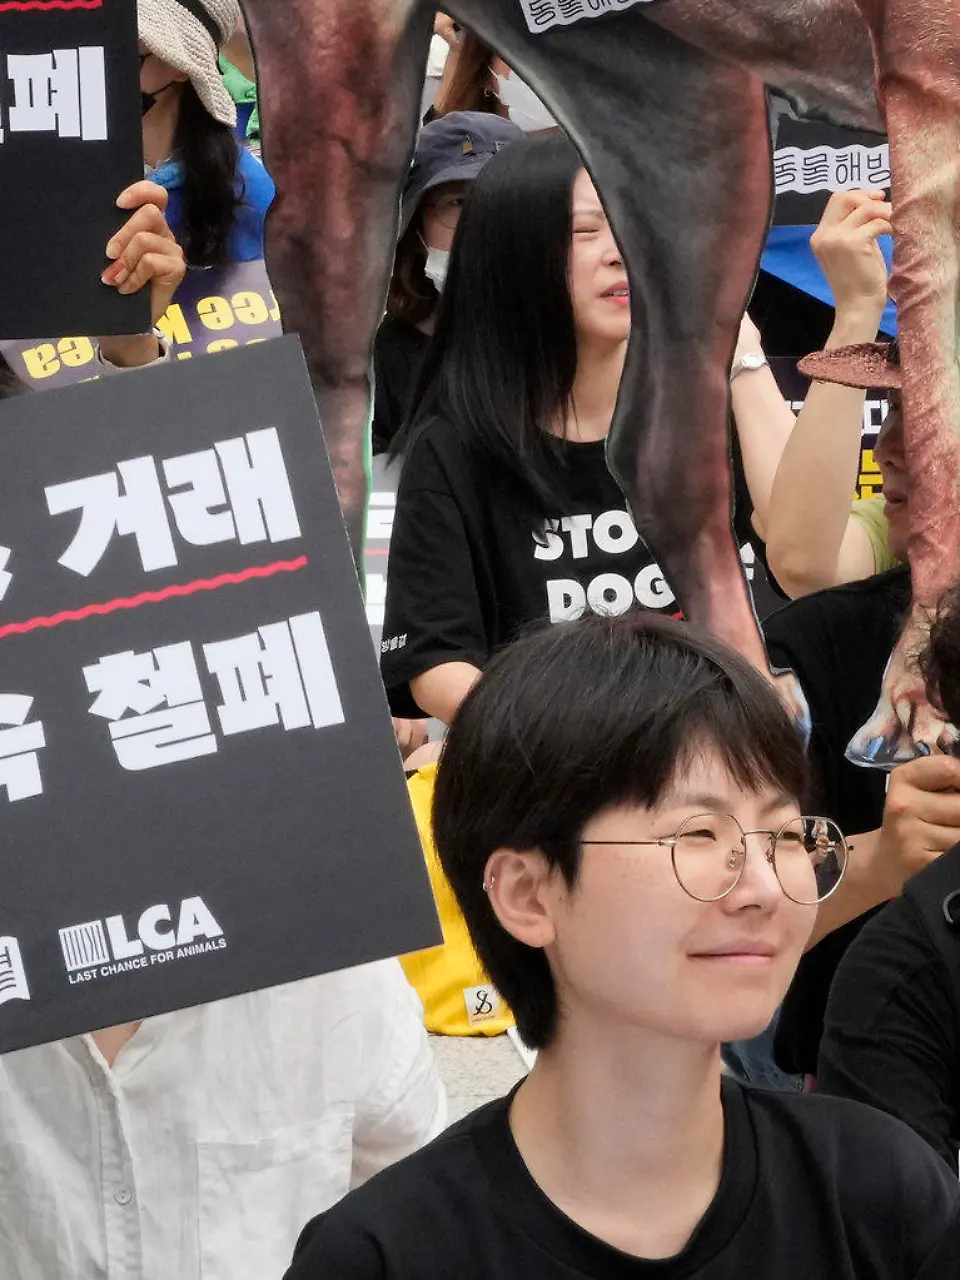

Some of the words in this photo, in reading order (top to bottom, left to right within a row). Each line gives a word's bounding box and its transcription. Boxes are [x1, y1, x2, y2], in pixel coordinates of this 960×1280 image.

[44, 427, 303, 577] 거래
[532, 509, 640, 561] STO
[546, 563, 677, 624] DOG
[105, 895, 224, 961] LCA
[68, 969, 98, 985] LAST
[100, 956, 149, 978] CHANCE
[149, 947, 175, 966] FOR
[176, 937, 227, 959] ANIMALS
